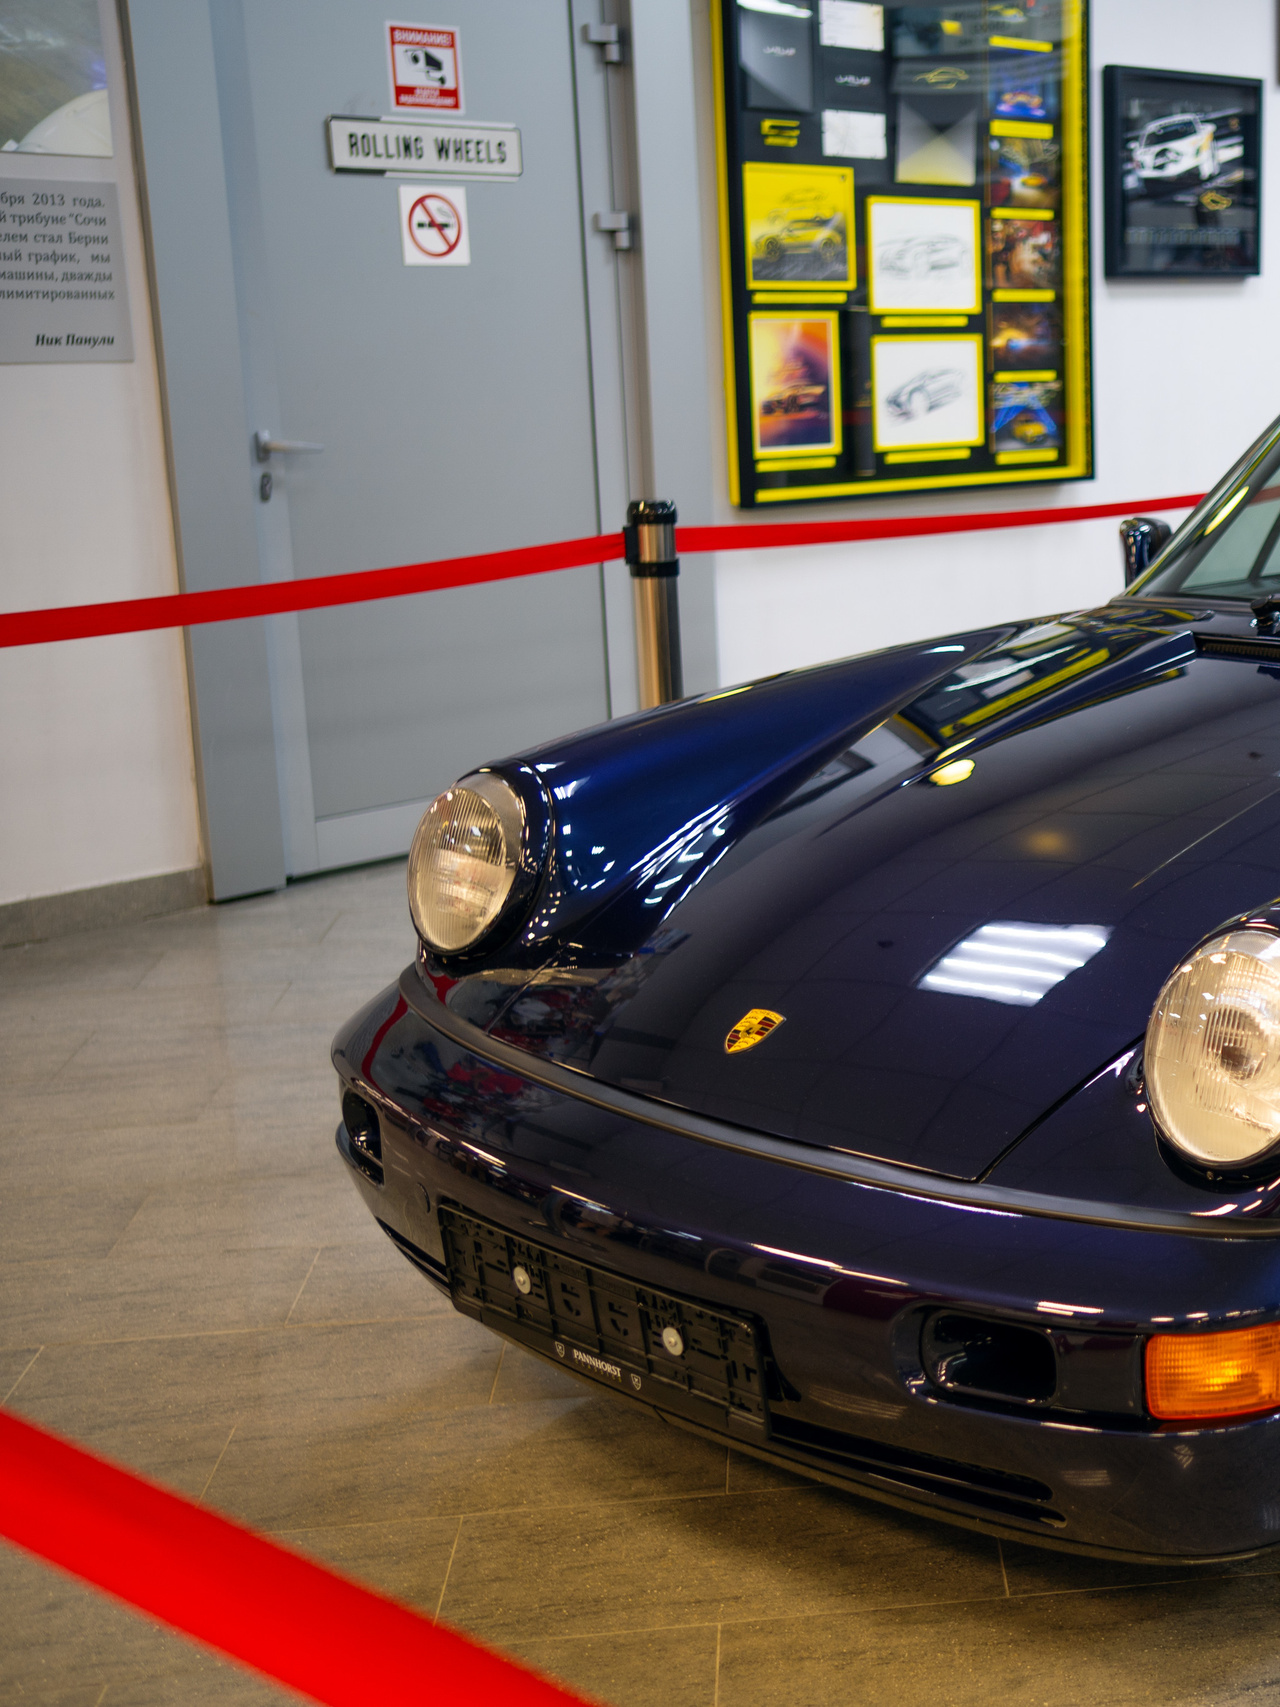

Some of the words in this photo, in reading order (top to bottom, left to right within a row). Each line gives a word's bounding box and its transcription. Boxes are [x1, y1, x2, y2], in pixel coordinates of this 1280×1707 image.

[348, 133, 424, 159] ROLLING
[434, 137, 507, 163] WHEELS
[32, 193, 65, 206] 2013
[72, 196, 105, 209] года.
[10, 212, 66, 227] трибуне
[33, 234, 63, 244] стал
[68, 232, 109, 247] Берни
[28, 251, 81, 266] график,
[91, 254, 111, 264] мы
[61, 272, 113, 284] дважды
[35, 333, 62, 347] Ник
[65, 333, 115, 349] Панули
[573, 1349, 621, 1377] PANNHORST
